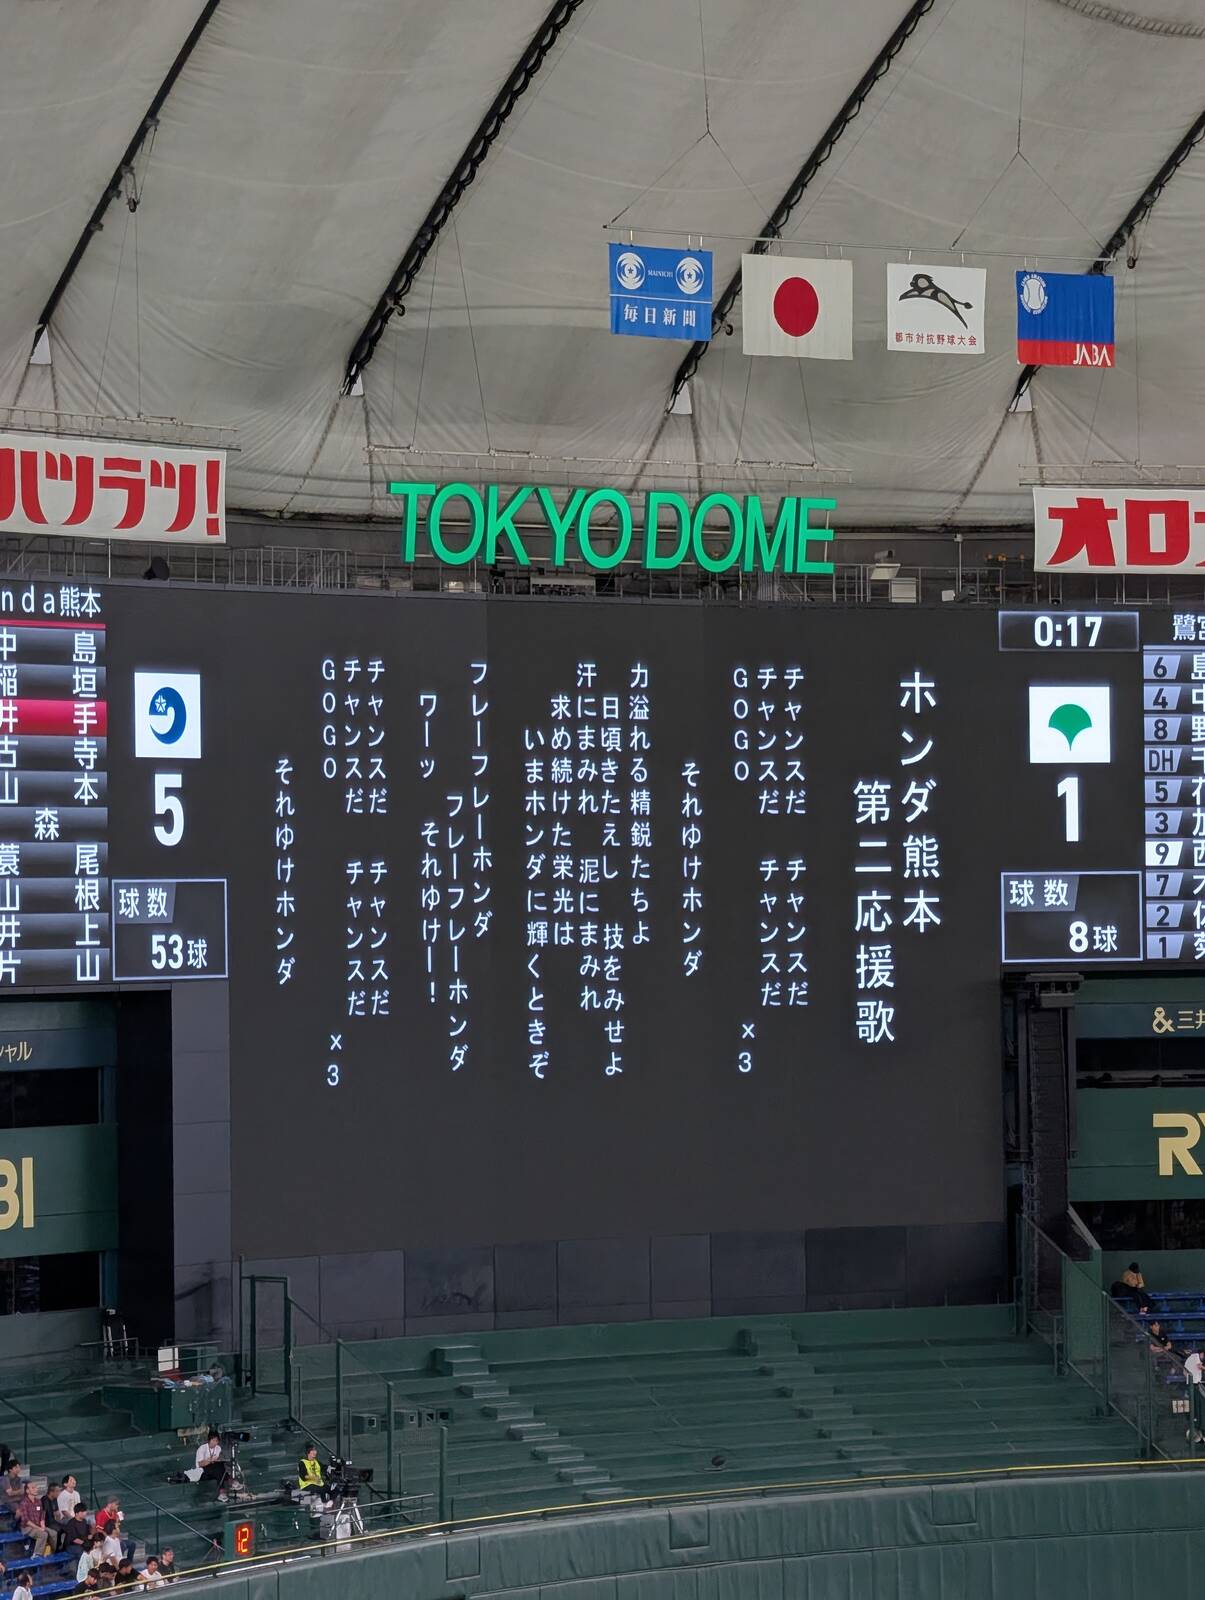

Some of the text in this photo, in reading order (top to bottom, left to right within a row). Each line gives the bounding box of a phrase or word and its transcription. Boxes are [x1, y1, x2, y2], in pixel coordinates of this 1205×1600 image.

[623, 303, 696, 328] 毎日新聞
[895, 331, 977, 346] 都市対抗野球大会
[1072, 343, 1112, 367] JABA
[387, 481, 837, 575] TOKYO DOME
[1033, 615, 1103, 648] 0:17
[1153, 656, 1167, 678] 6
[1153, 687, 1168, 709] 4
[322, 659, 337, 779] GOGO
[733, 667, 750, 781] GOGO
[1154, 718, 1168, 740] 8
[1149, 750, 1174, 772] DH
[470, 663, 493, 938] フレーフレーホンダ
[629, 663, 652, 945] 力溢れる精鋭たちよ
[900, 671, 941, 933] ホンダ熊本
[1155, 781, 1168, 802] 5
[35, 808, 60, 840] 森
[153, 773, 185, 847] 5
[550, 694, 575, 946] 求め続けた栄光は
[1057, 776, 1079, 842] 1
[1155, 812, 1169, 834] 3
[576, 663, 602, 1011] 汗にまみれ 泥にまみれ
[1155, 843, 1169, 864] 9
[275, 758, 296, 985] それゆけホンダ
[601, 696, 625, 1076] 日頃きたえし 技をみせよ
[681, 762, 703, 977] それゆけホンダ
[1156, 874, 1169, 895] 7
[118, 887, 168, 919] 球数
[524, 729, 550, 1079] いまホンダに輝くときぞ
[1009, 878, 1069, 908] 球数
[854, 780, 895, 1043] 第二応援歌
[1156, 905, 1170, 927] 2
[446, 795, 469, 1071] フレーフレーホンダ
[1158, 937, 1167, 958] 1
[1152, 1112, 1205, 1176] R
[237, 1527, 249, 1553] 12
